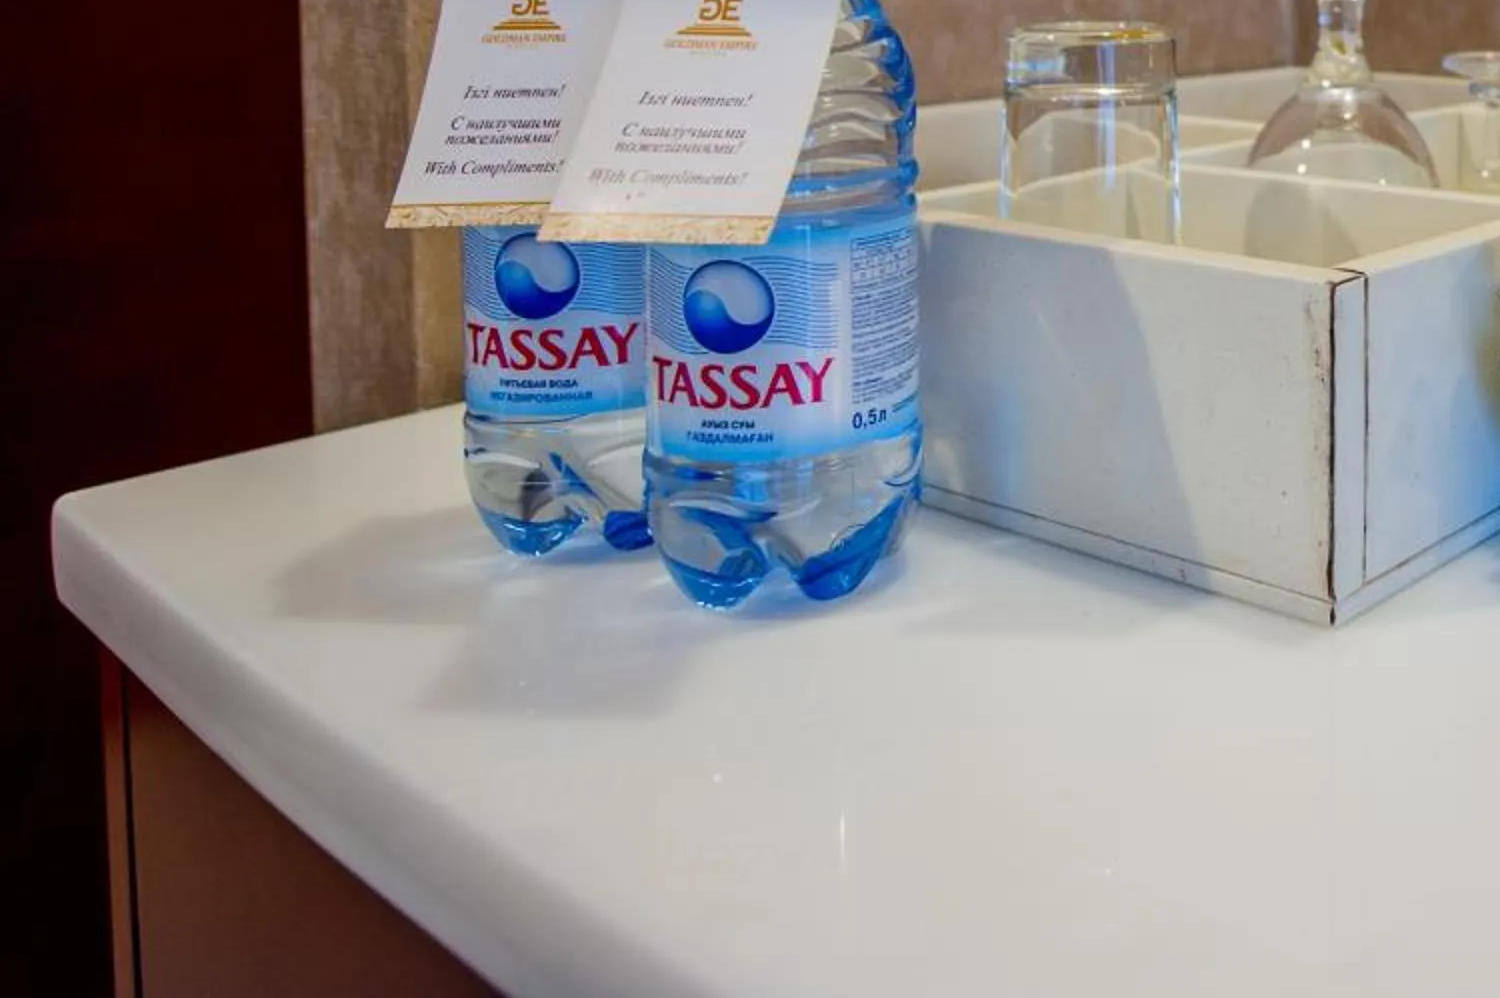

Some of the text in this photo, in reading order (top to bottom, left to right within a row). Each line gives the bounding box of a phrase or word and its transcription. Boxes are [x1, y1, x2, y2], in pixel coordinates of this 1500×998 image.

[425, 159, 566, 178] With Compliments!
[467, 322, 639, 371] TASSAY
[652, 355, 835, 411] TASSAY
